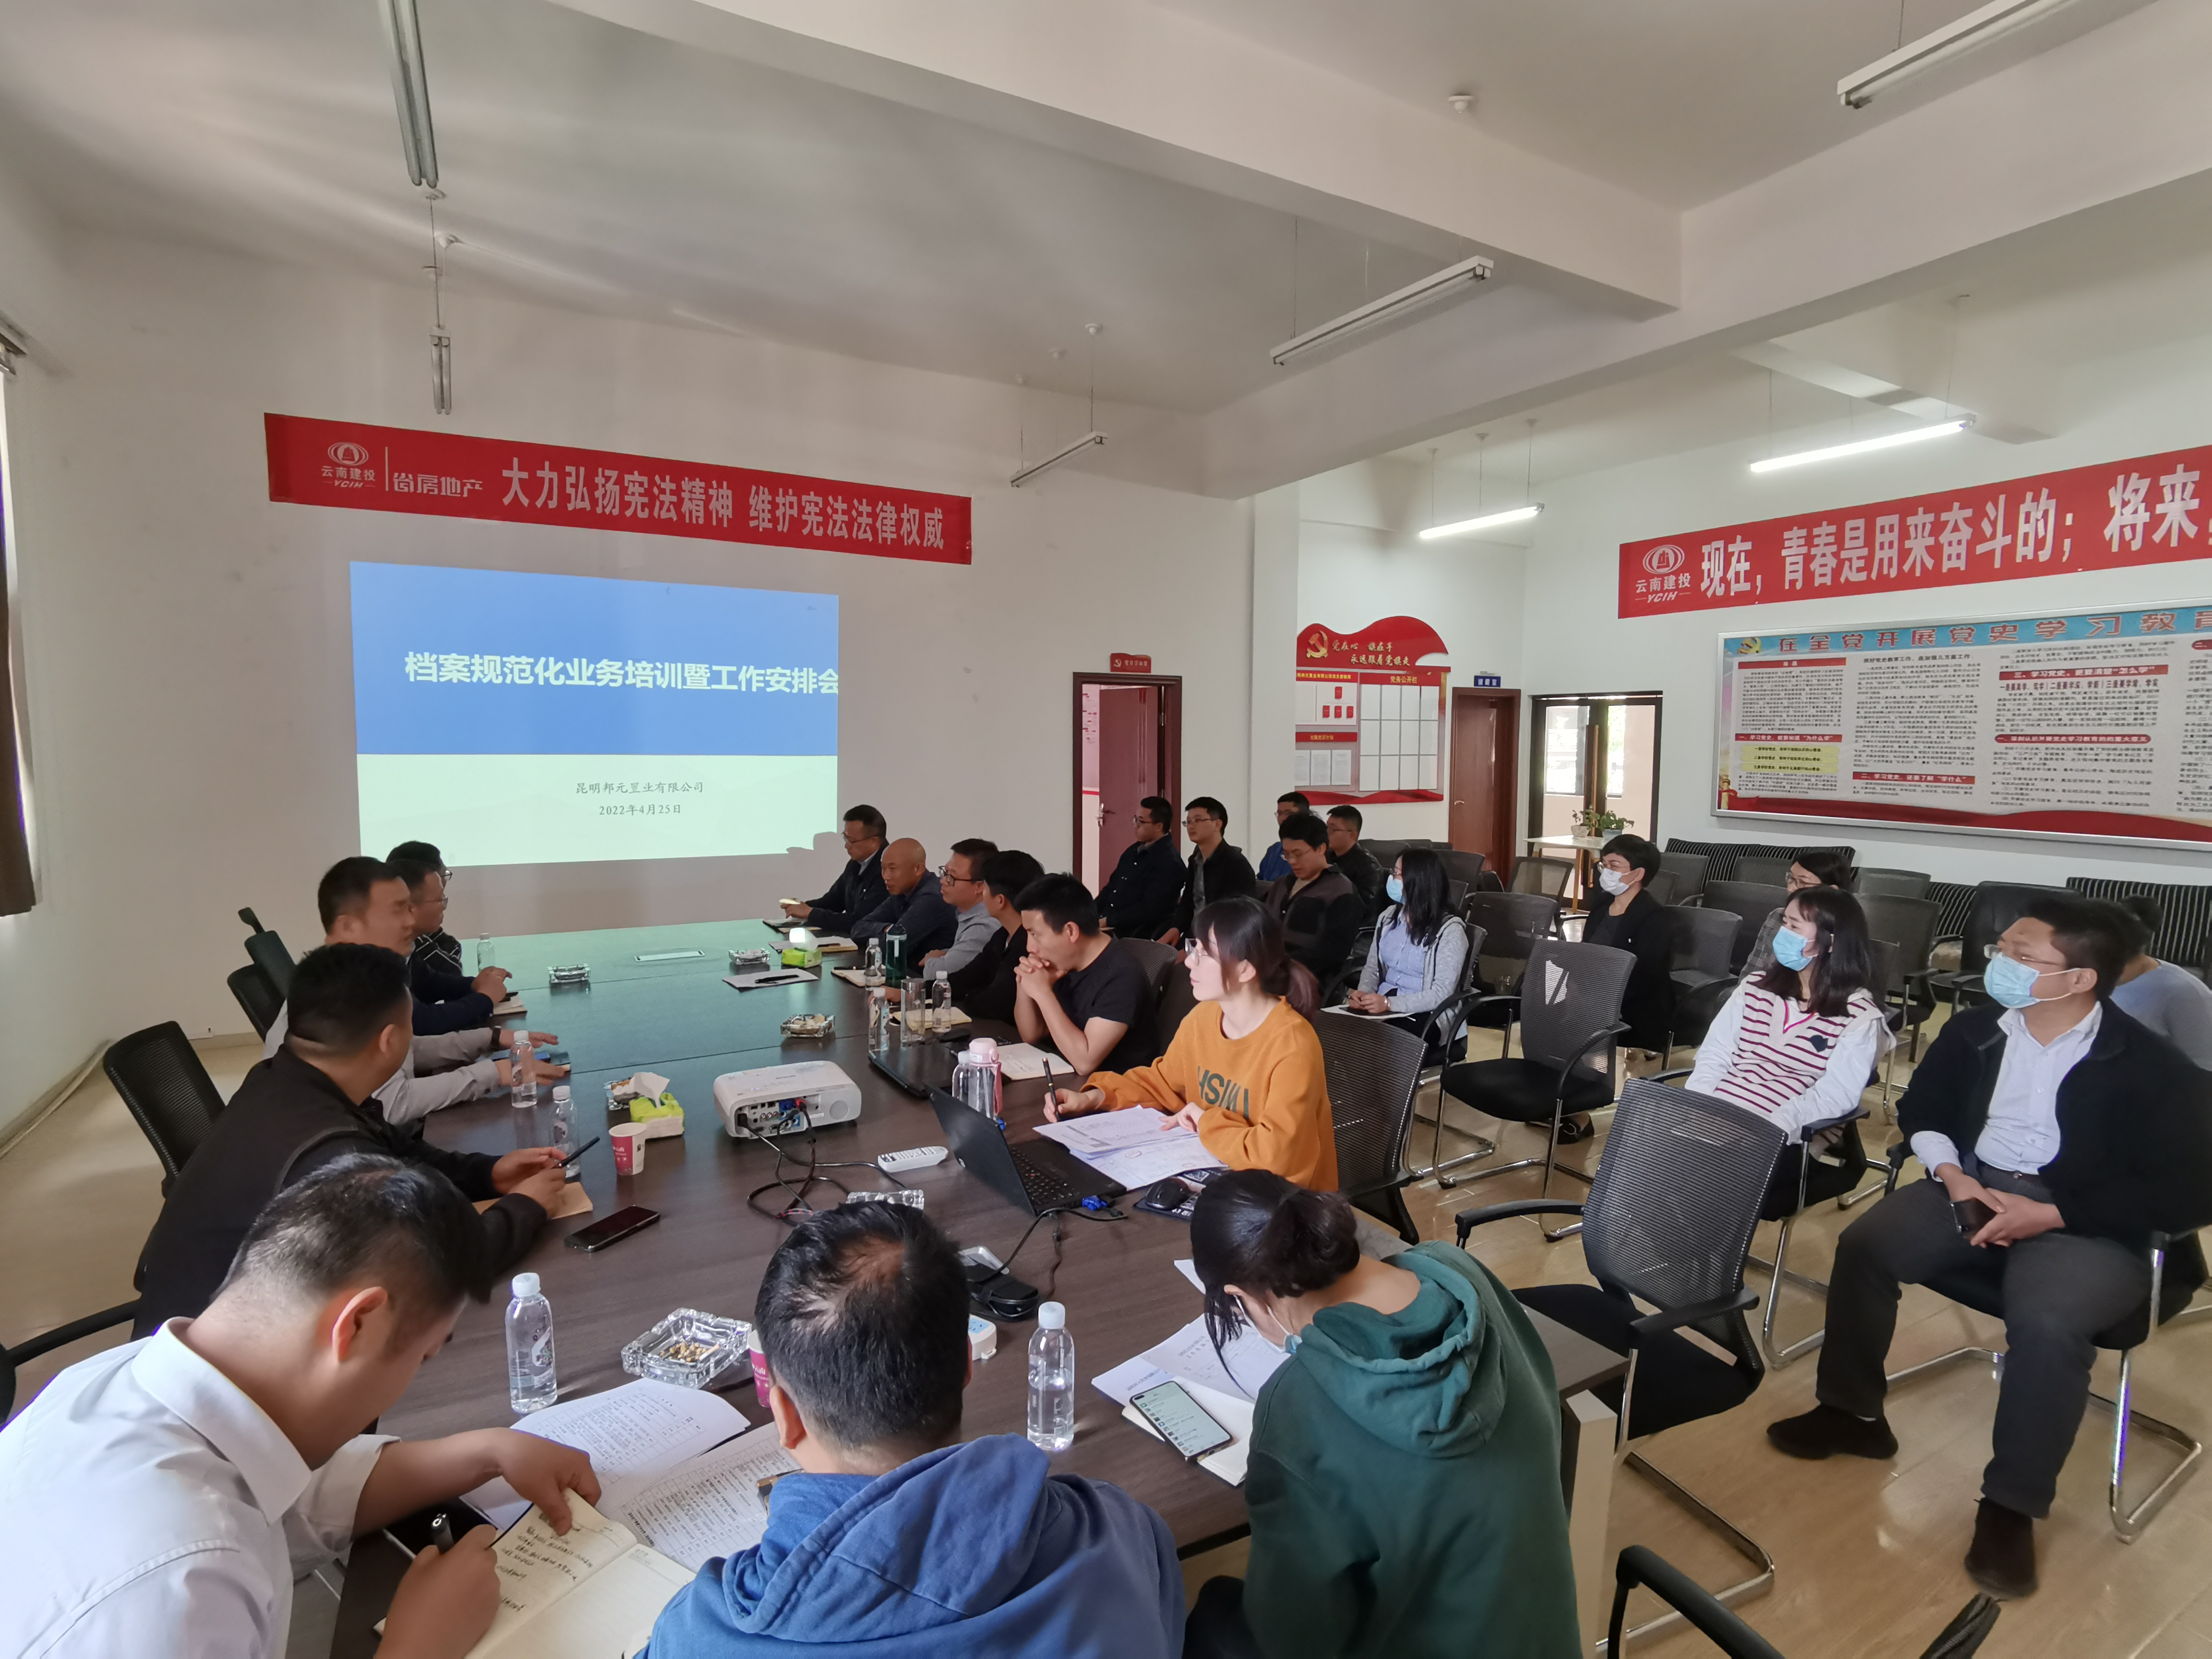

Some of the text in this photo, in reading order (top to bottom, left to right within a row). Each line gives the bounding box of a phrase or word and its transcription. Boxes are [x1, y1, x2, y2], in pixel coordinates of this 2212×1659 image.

[321, 465, 376, 482] 云南建投
[333, 481, 364, 489] YCIH
[502, 457, 945, 550] 大力弘扬宪法精神 维护宪法法律权威
[1700, 464, 2212, 598] 现在，青春是用来奋斗的；将来
[1635, 573, 1691, 593] 云南建投
[1647, 591, 1678, 603] YCIH
[404, 651, 839, 695] 档案规范化业务培训暨工作安排会
[576, 781, 704, 794] 昆明邦元置业有限公司
[599, 804, 682, 816] 2022年4月25日
